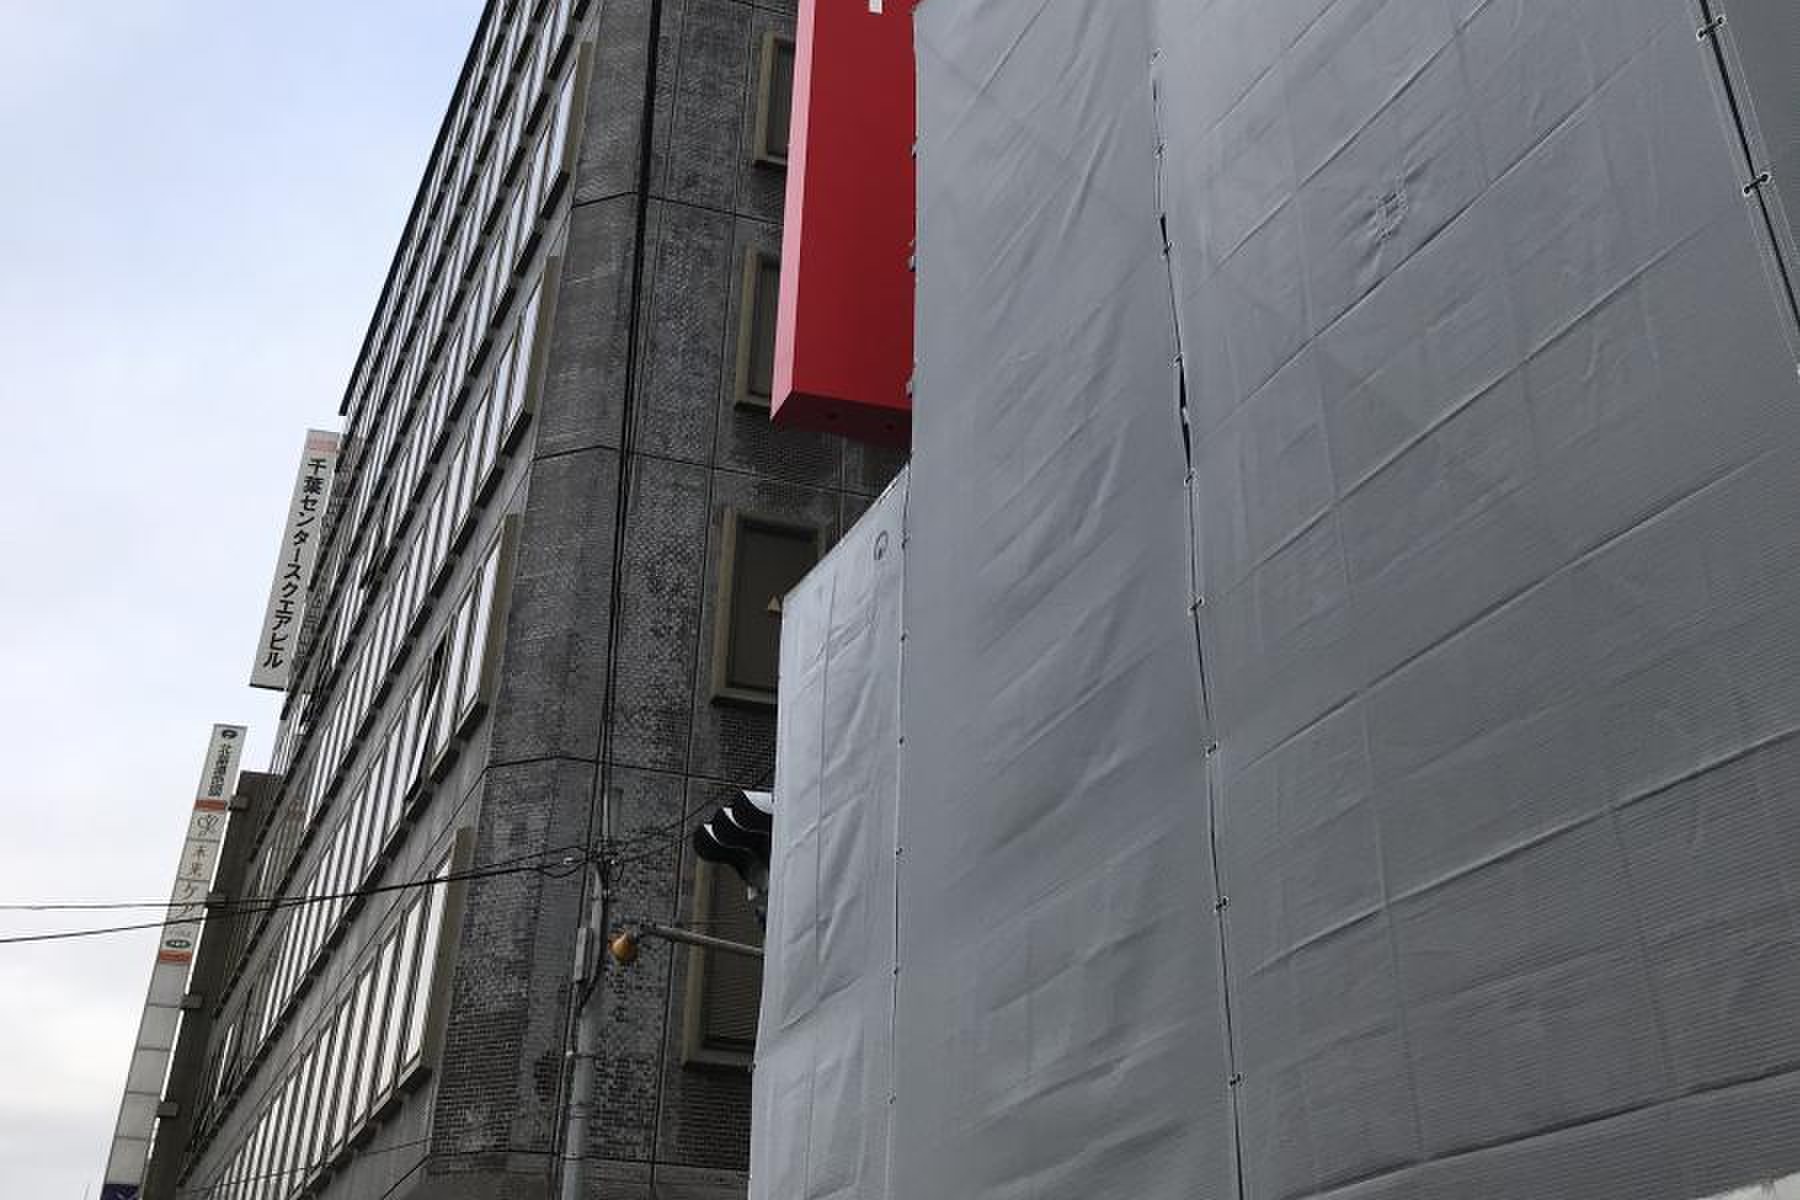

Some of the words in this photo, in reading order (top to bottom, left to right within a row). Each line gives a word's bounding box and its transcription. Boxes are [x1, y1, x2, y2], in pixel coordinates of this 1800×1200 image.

[262, 458, 327, 669] 千葉センタースクエアビル
